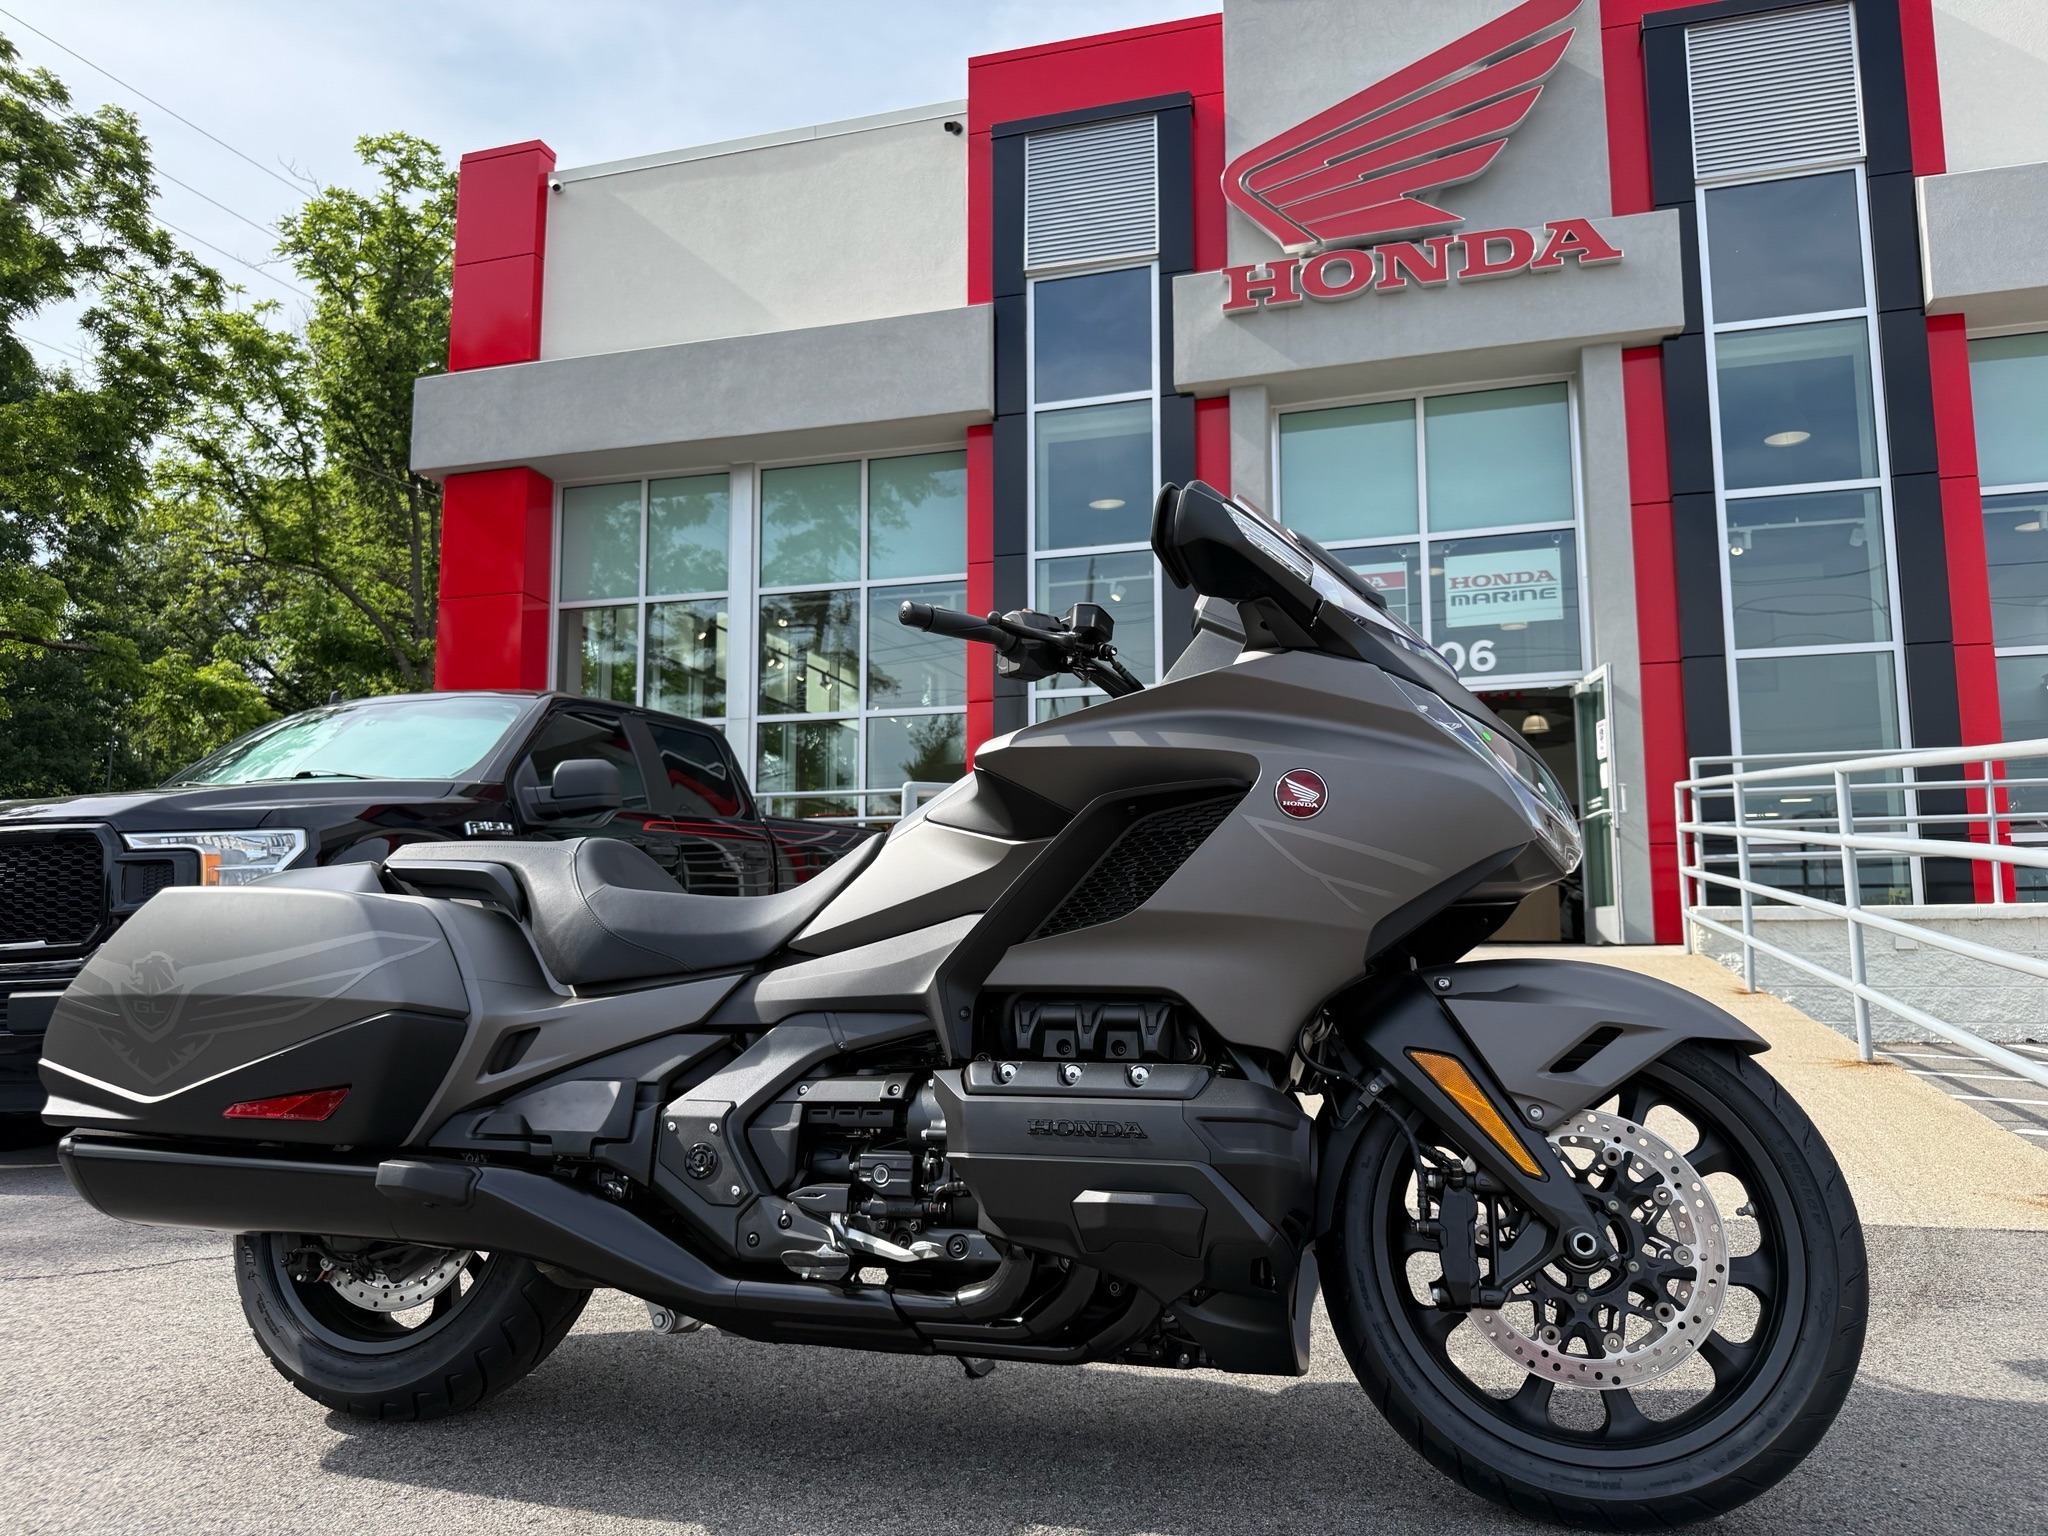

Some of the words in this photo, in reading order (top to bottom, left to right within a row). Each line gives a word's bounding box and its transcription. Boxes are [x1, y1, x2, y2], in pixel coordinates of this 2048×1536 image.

[1221, 217, 1624, 316] HONDA
[1449, 569, 1557, 590] HONDA
[1450, 587, 1558, 607] MARINE
[1282, 800, 1319, 809] HONDA
[134, 1000, 167, 1014] GL
[1027, 1118, 1148, 1140] HONDA
